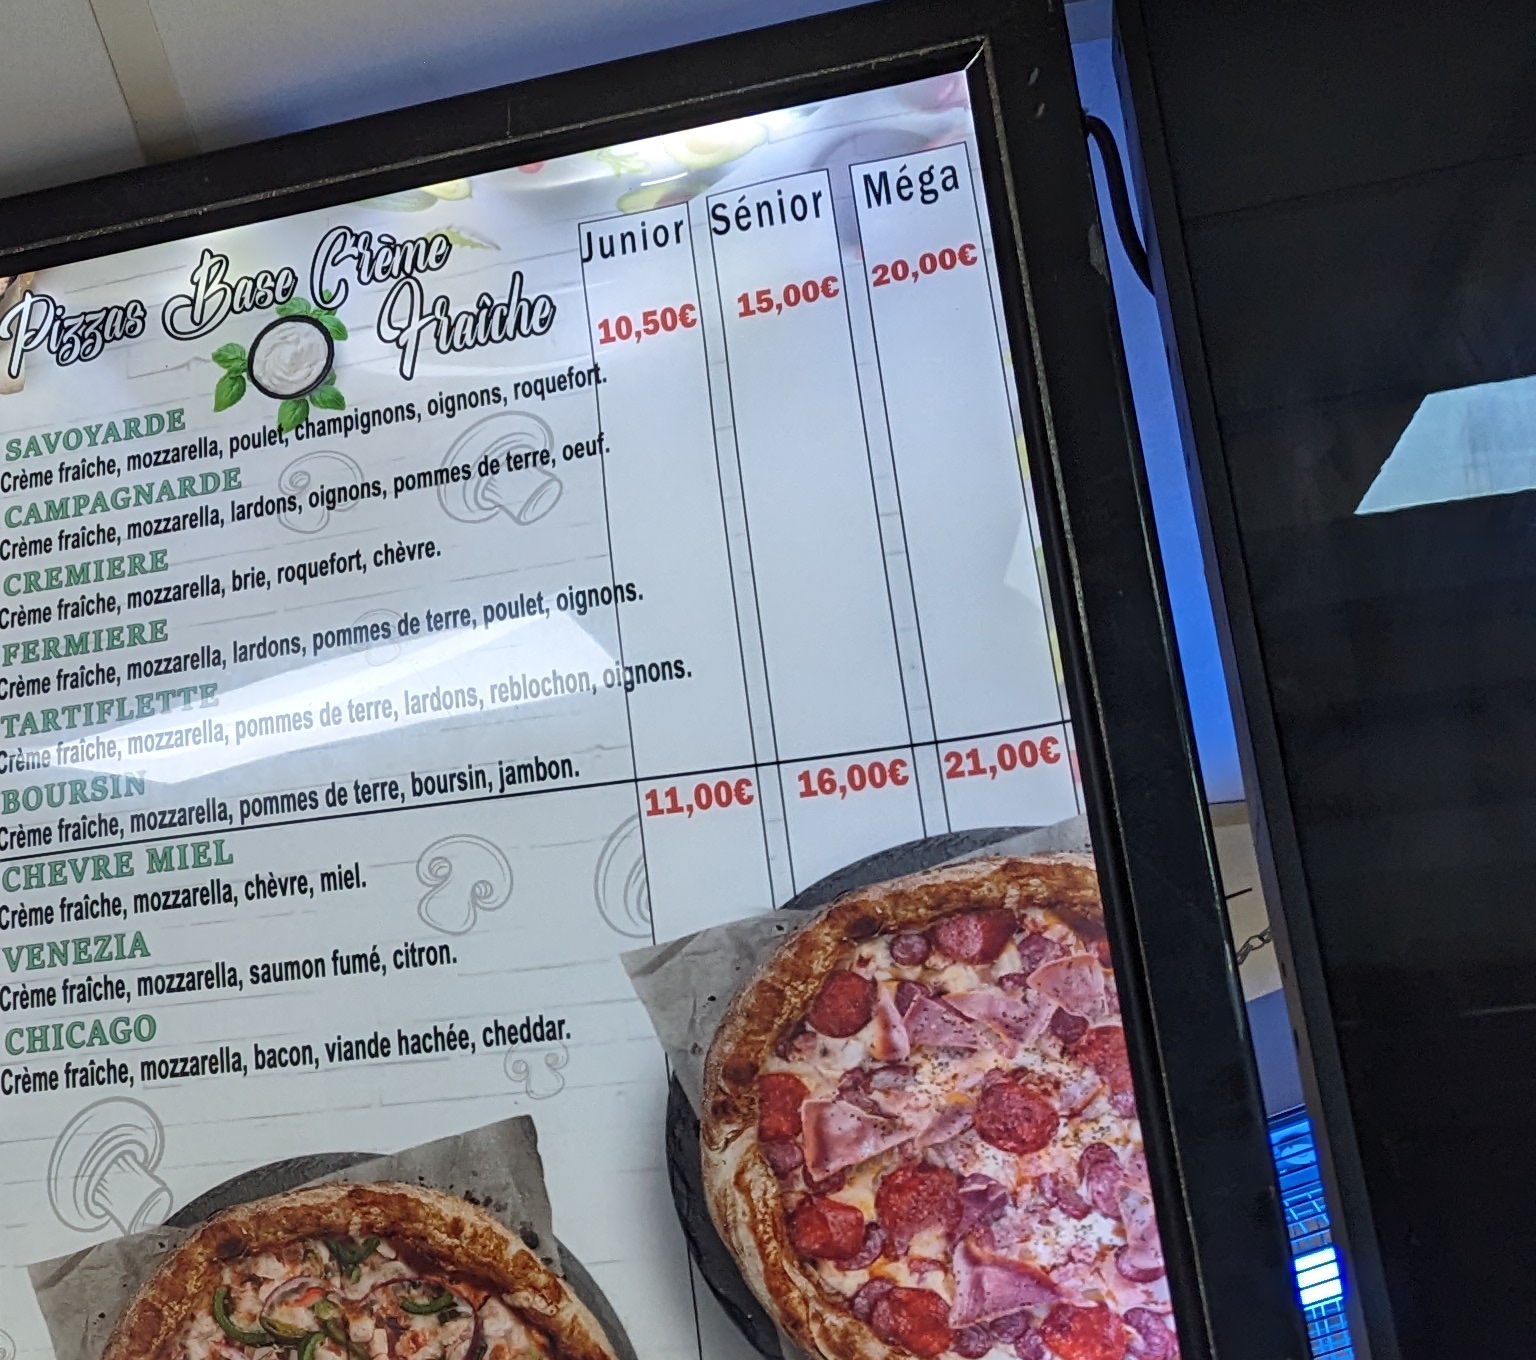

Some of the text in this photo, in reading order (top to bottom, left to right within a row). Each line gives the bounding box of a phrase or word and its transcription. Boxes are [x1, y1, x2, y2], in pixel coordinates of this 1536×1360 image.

[581, 162, 960, 263] Junior Sénior Méga
[162, 248, 298, 340] Base
[309, 225, 451, 311] Crème
[597, 242, 977, 345] 10,50€ 15,00€ 20,00€
[376, 271, 556, 381] Fraîche
[5, 407, 186, 462] SAVOYARDE
[3, 466, 245, 529] CAMPAGNARDE
[3, 548, 169, 598] CREMIERE
[1, 618, 169, 668] FERMIERE
[0, 770, 146, 816] BOURSIN
[644, 735, 1061, 818] 11,00€ 16,00€ 21,00€
[1, 838, 235, 893] CHEVRE MIEL
[0, 941, 458, 1012] Crème fraîche, mozzarella, saumon fumé, citron.
[1, 930, 152, 974] VENEZIA
[1, 1014, 571, 1096] Crème fraîche, mozzarella, bacon, viande hachée, cheddar.
[4, 1013, 157, 1057] CHICAGO
